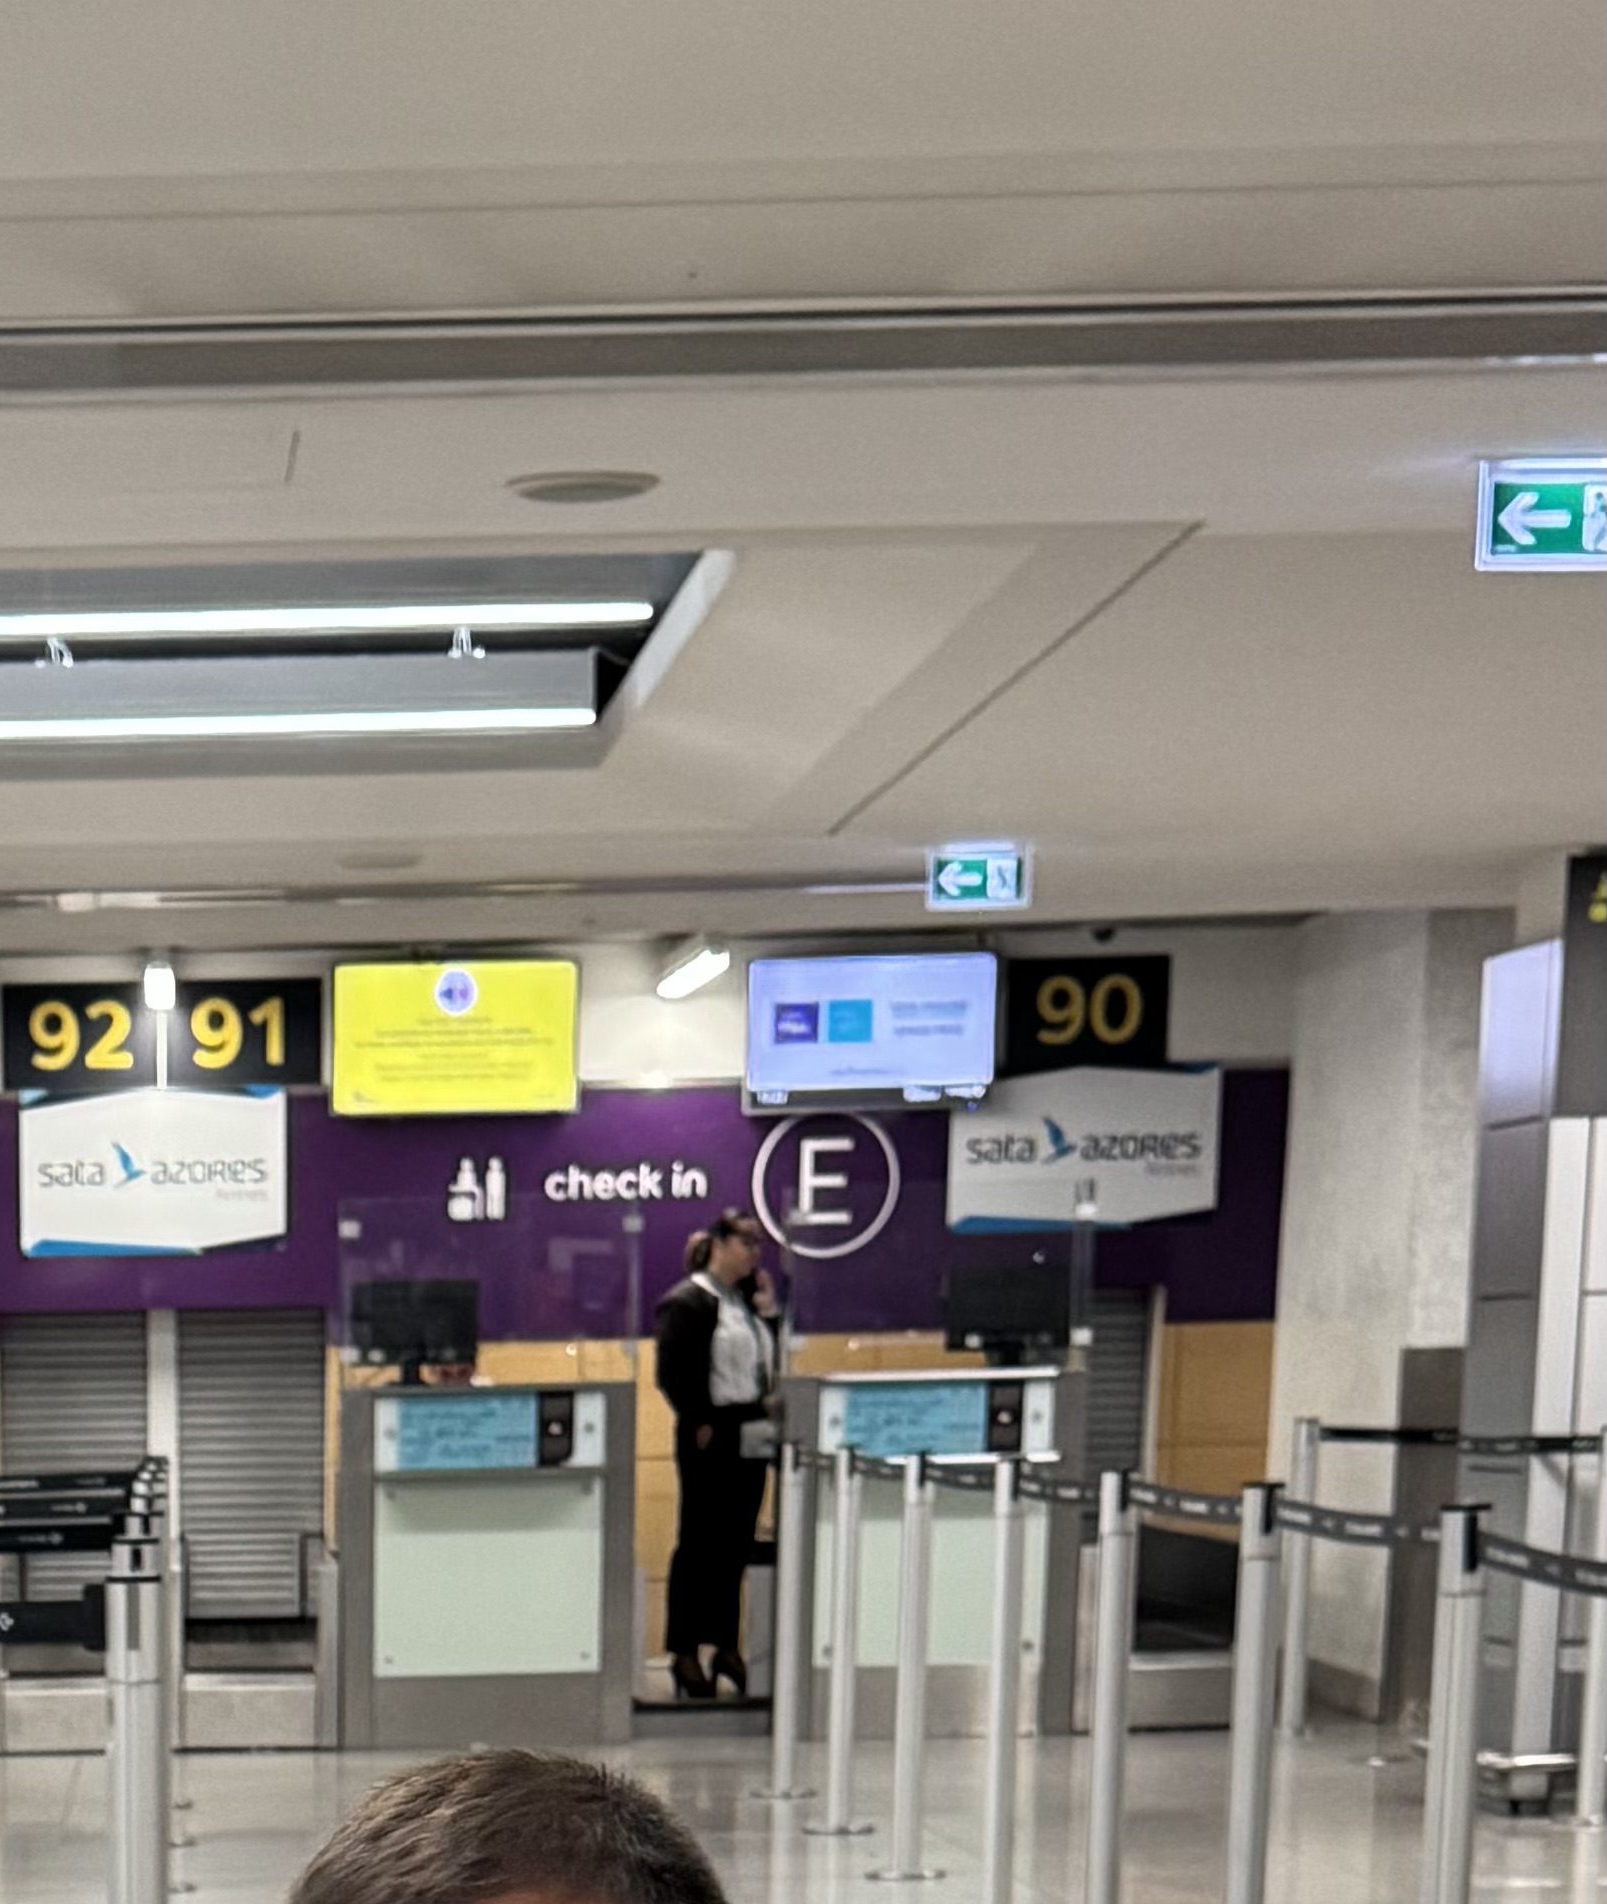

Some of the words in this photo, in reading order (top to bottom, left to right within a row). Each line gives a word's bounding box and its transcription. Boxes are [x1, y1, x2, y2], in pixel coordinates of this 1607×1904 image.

[28, 1000, 134, 1071] 92
[190, 997, 285, 1069] 91
[1036, 974, 1142, 1044] 90
[37, 1159, 105, 1188] sata
[544, 1162, 663, 1201] check
[671, 1160, 708, 1199] in
[798, 1136, 855, 1225] E
[965, 1133, 1038, 1164] sata
